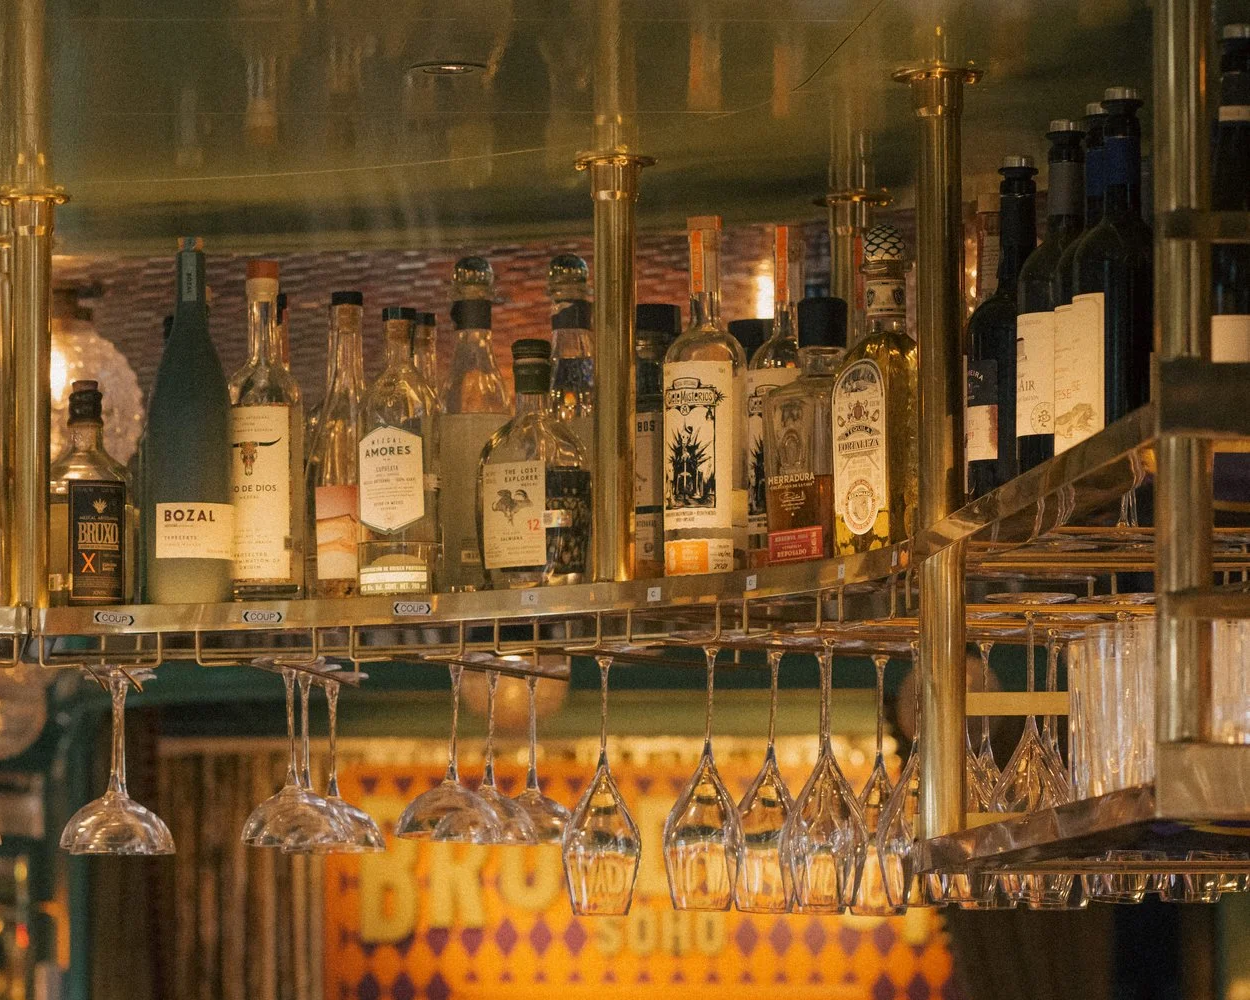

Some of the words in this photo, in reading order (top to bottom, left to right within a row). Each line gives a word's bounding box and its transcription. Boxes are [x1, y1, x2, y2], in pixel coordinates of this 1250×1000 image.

[365, 445, 411, 457] AMORES
[504, 475, 538, 483] EXPLORER
[768, 471, 815, 486] HERRADURA
[255, 484, 277, 492] DIOS
[164, 509, 215, 522] BOZAL
[527, 518, 540, 531] 12
[81, 552, 96, 573] X
[400, 604, 425, 612] COUP
[101, 614, 128, 624] COUP
[250, 613, 276, 621] COUP
[594, 907, 727, 957] SOHO
